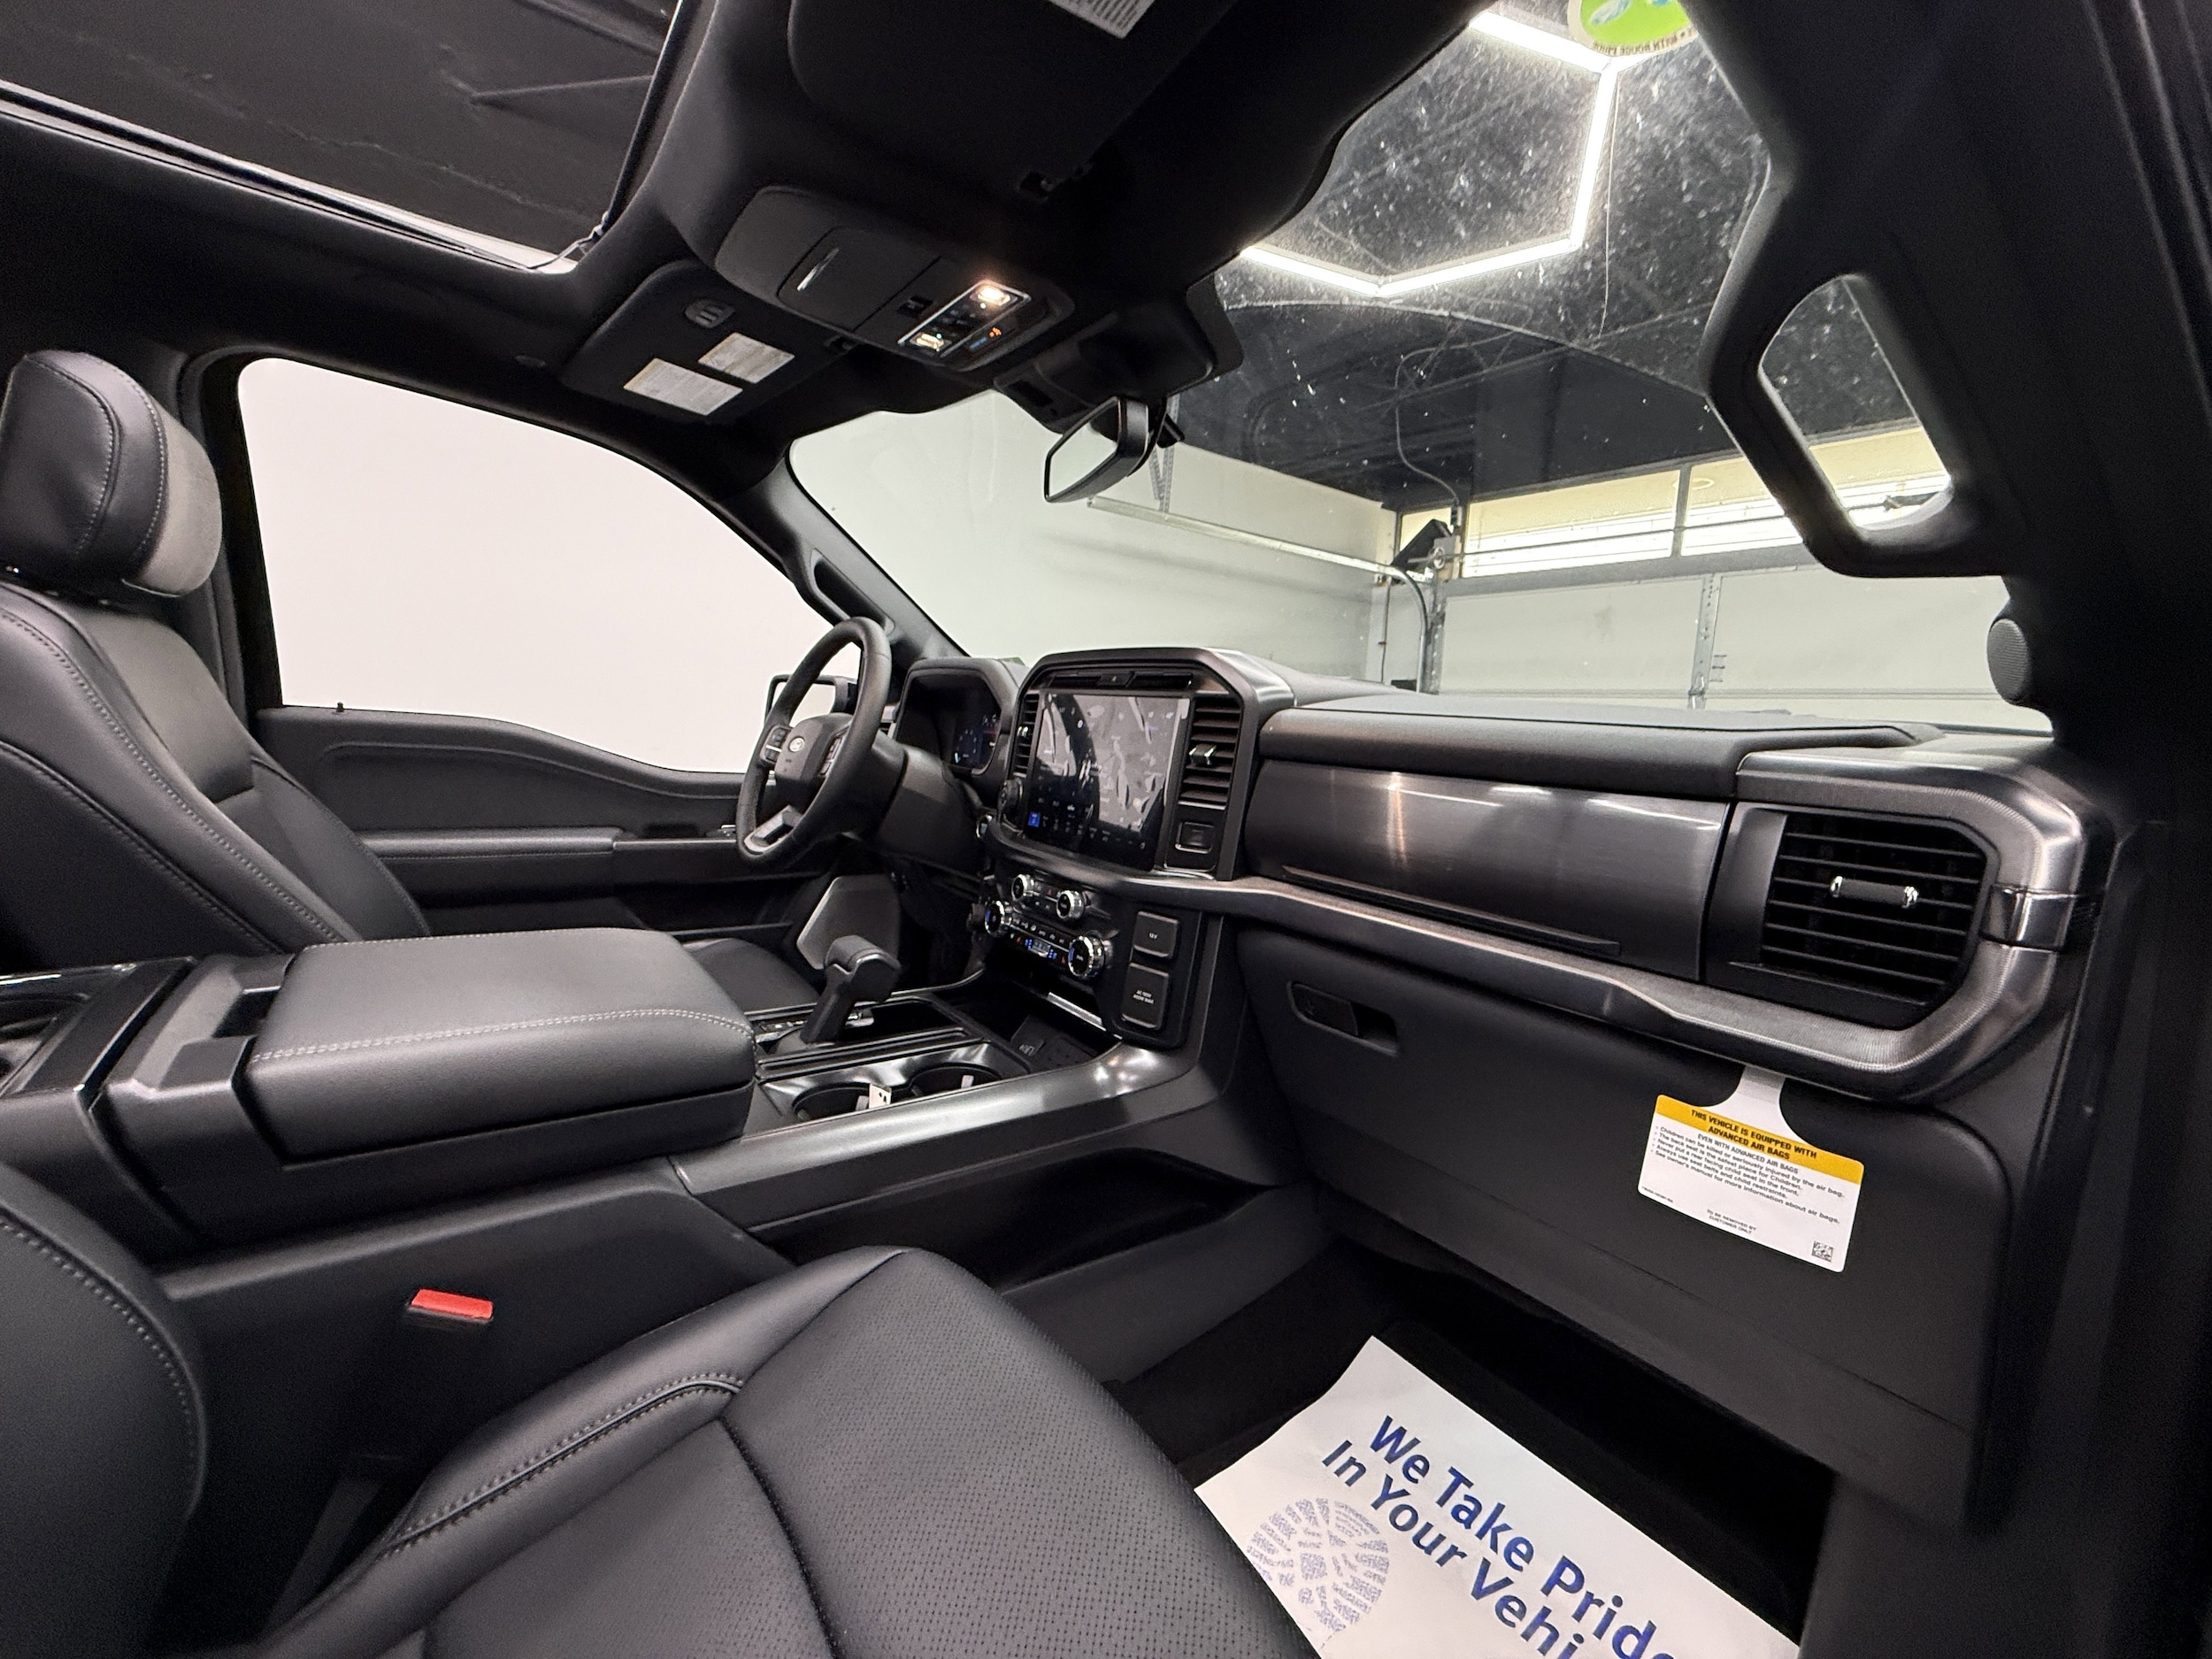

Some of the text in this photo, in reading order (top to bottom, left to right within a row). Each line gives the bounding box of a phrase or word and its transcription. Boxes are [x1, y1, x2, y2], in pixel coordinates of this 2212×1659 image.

[1658, 1139, 1674, 1148] Never
[1704, 1157, 1724, 1169] facing
[1659, 1132, 1670, 1141] The
[1717, 1156, 1737, 1166] safest
[1739, 1164, 1757, 1174] place
[1758, 1170, 1769, 1179] for
[1660, 1126, 1685, 1139] Children
[1706, 1145, 1724, 1154] killed
[1732, 1155, 1763, 1170] seriously
[1792, 1175, 1801, 1184] by
[1802, 1179, 1815, 1187] the
[1691, 1110, 1816, 1157] THIS VEHICLE IS EQUIPPED WITH
[1709, 1125, 1790, 1159] ADVANCED AIR BAGS
[1714, 1140, 1730, 1149] WITH
[1732, 1147, 1765, 1162] ADVANCED
[1766, 1158, 1778, 1167] AIR
[1780, 1164, 1799, 1173] BAGS
[1655, 1149, 1666, 1158] See
[1691, 1165, 1713, 1177] manual
[1724, 1179, 1741, 1188] more
[1743, 1186, 1784, 1203] information
[1785, 1201, 1806, 1211] about
[1656, 1145, 1677, 1156] Always
[1720, 1170, 1732, 1179] and
[1734, 1176, 1751, 1185] child
[1321, 1439, 1367, 1488] In
[1370, 1473, 1468, 1568] Your
[1371, 1415, 1675, 1659] We Take Prid
